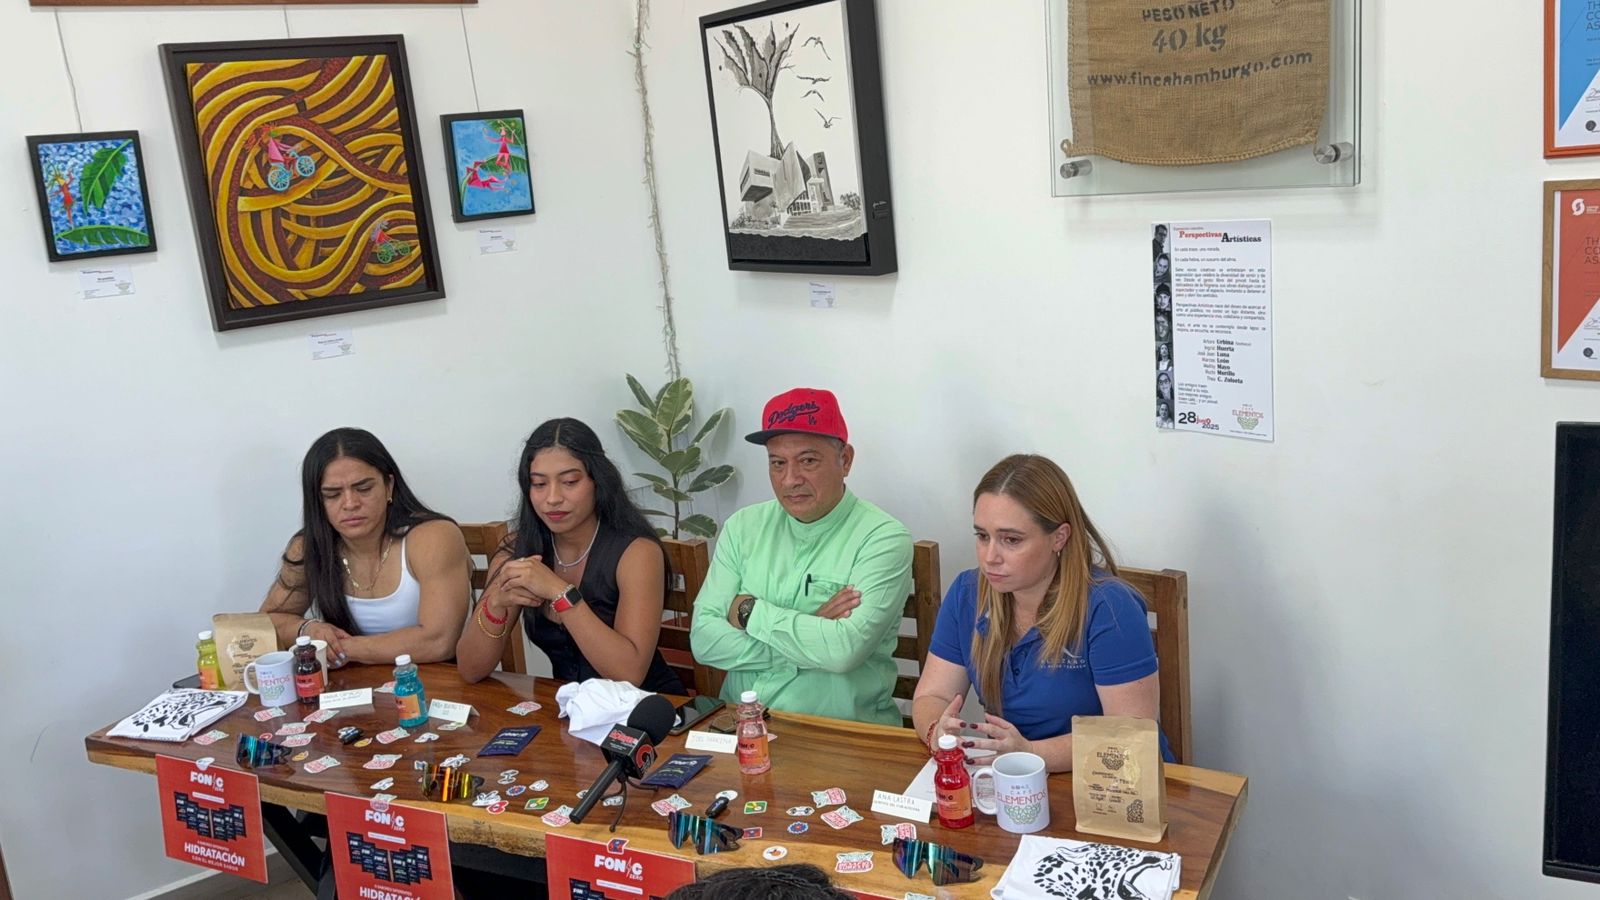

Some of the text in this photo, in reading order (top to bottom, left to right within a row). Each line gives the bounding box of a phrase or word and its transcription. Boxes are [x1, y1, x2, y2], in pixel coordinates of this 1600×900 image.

[1153, 22, 1228, 53] 40 kg
[1087, 52, 1313, 87] www.fincahamburgo.com
[1179, 230, 1262, 242] Perspectivas Artísticas
[768, 401, 820, 429] Dodgers
[1178, 412, 1196, 424] 28
[1232, 410, 1264, 418] ELEMENTOS
[996, 789, 1047, 805] ELEMENTOS
[184, 842, 245, 867] HIDRATACIÓN
